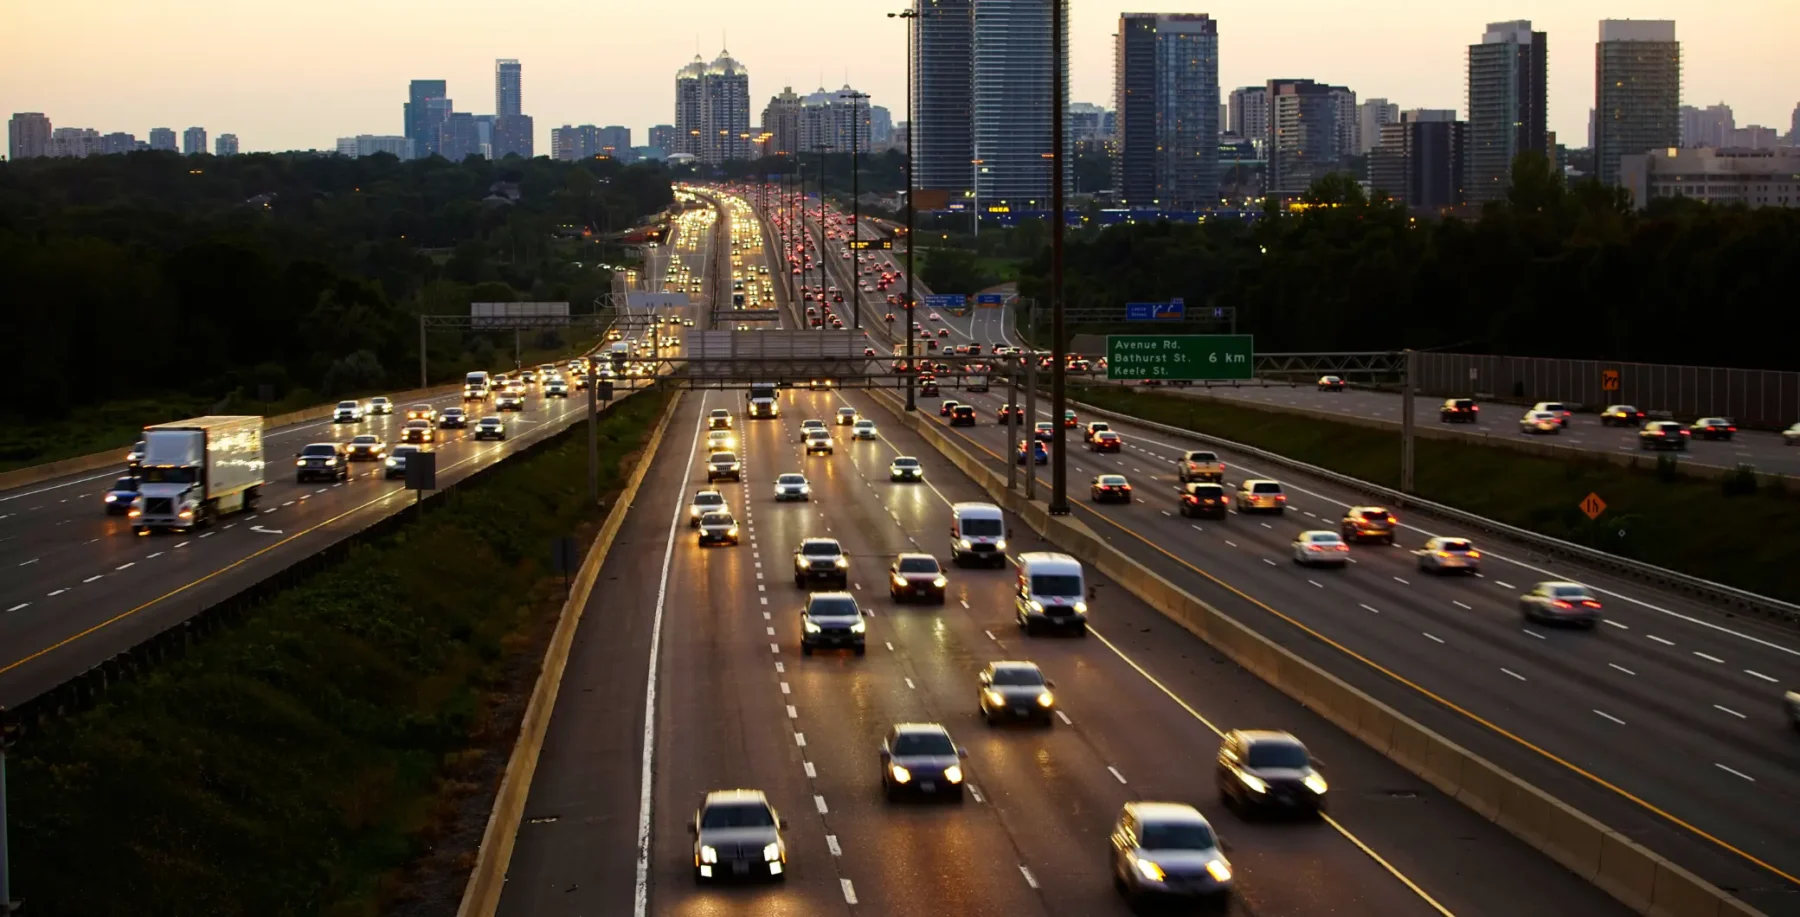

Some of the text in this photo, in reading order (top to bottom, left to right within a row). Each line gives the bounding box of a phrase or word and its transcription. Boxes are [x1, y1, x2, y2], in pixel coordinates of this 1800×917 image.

[1115, 340, 1180, 349] Avenue Rd.
[1115, 352, 1245, 363] Bathurst St. 6 km
[1114, 366, 1168, 375] Keele St.
